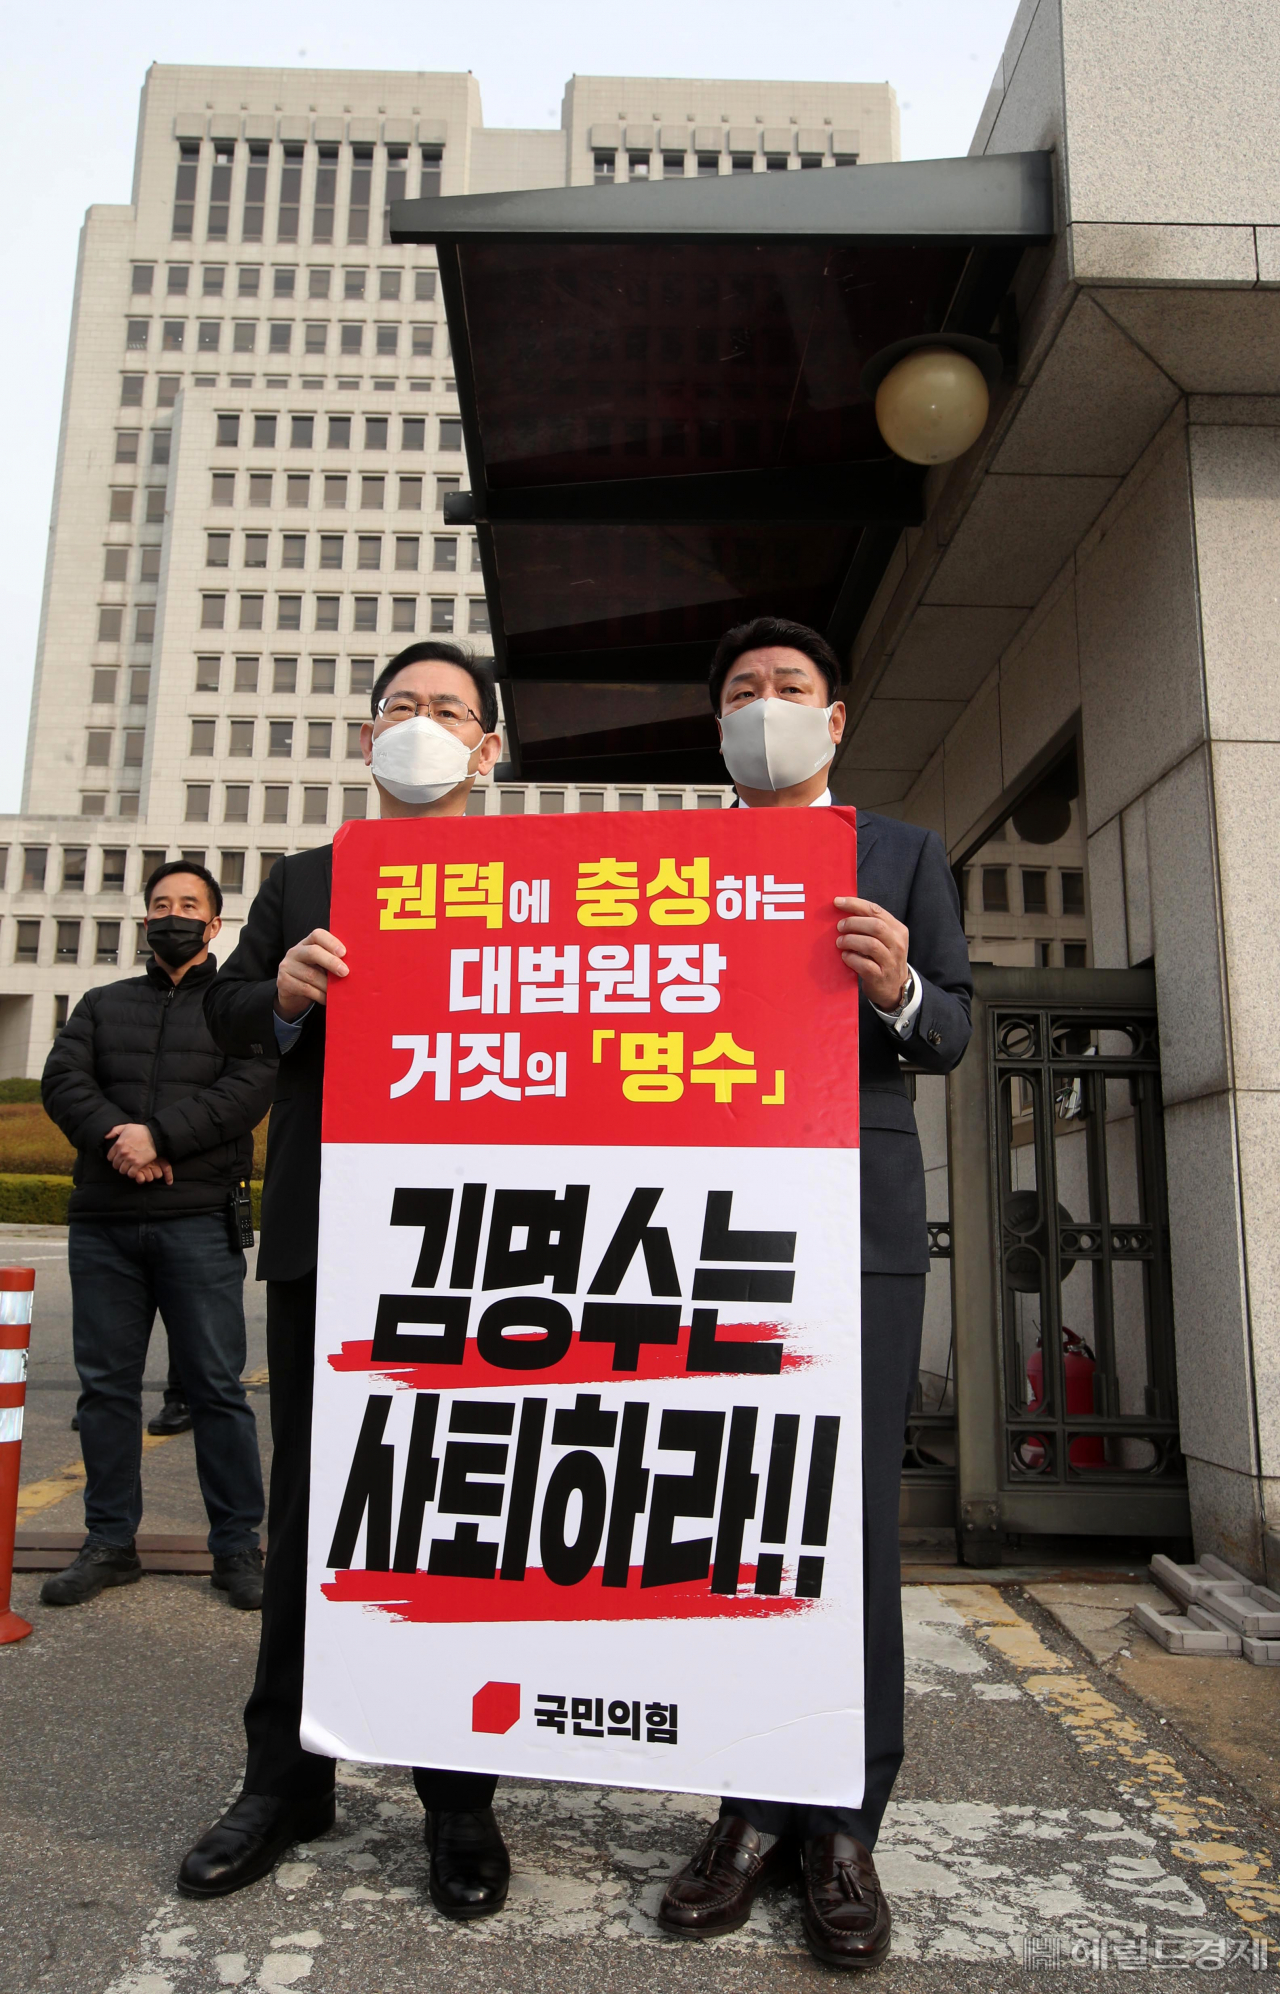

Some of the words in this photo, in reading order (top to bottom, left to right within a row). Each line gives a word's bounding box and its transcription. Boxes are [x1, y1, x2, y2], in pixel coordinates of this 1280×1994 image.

[376, 861, 551, 931] 권력에
[575, 856, 806, 927] 충성하는
[448, 943, 727, 1015] 대법원장
[389, 1031, 567, 1102] 거짓의
[370, 1182, 797, 1375] 김명수는
[325, 1392, 841, 1599] 사퇴하라!!
[534, 1694, 678, 1745] 국민의힘
